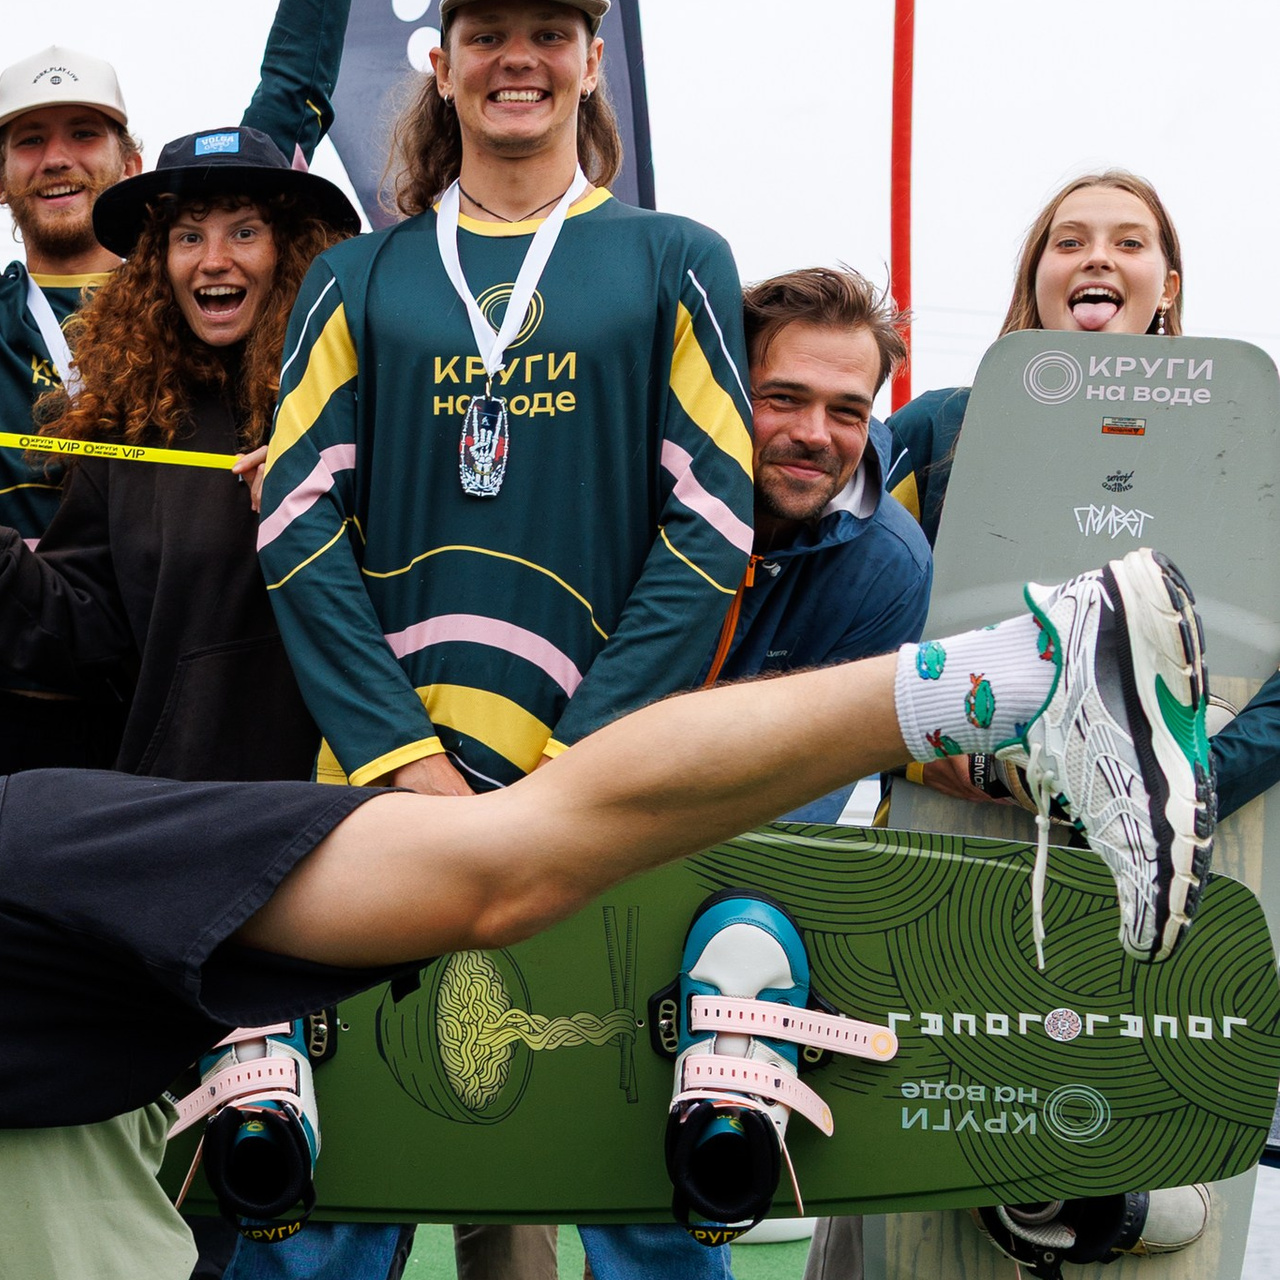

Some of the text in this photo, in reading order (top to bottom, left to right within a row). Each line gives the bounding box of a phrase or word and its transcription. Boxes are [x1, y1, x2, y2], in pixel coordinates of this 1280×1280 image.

[201, 135, 234, 146] VOLGA
[1088, 356, 1213, 381] КРУГИ
[500, 390, 577, 418] оде
[1086, 384, 1211, 407] на воде
[57, 441, 80, 452] VIP
[122, 447, 145, 459] VIP
[901, 1079, 1038, 1104] на воде
[901, 1107, 1037, 1135] КРУГИ
